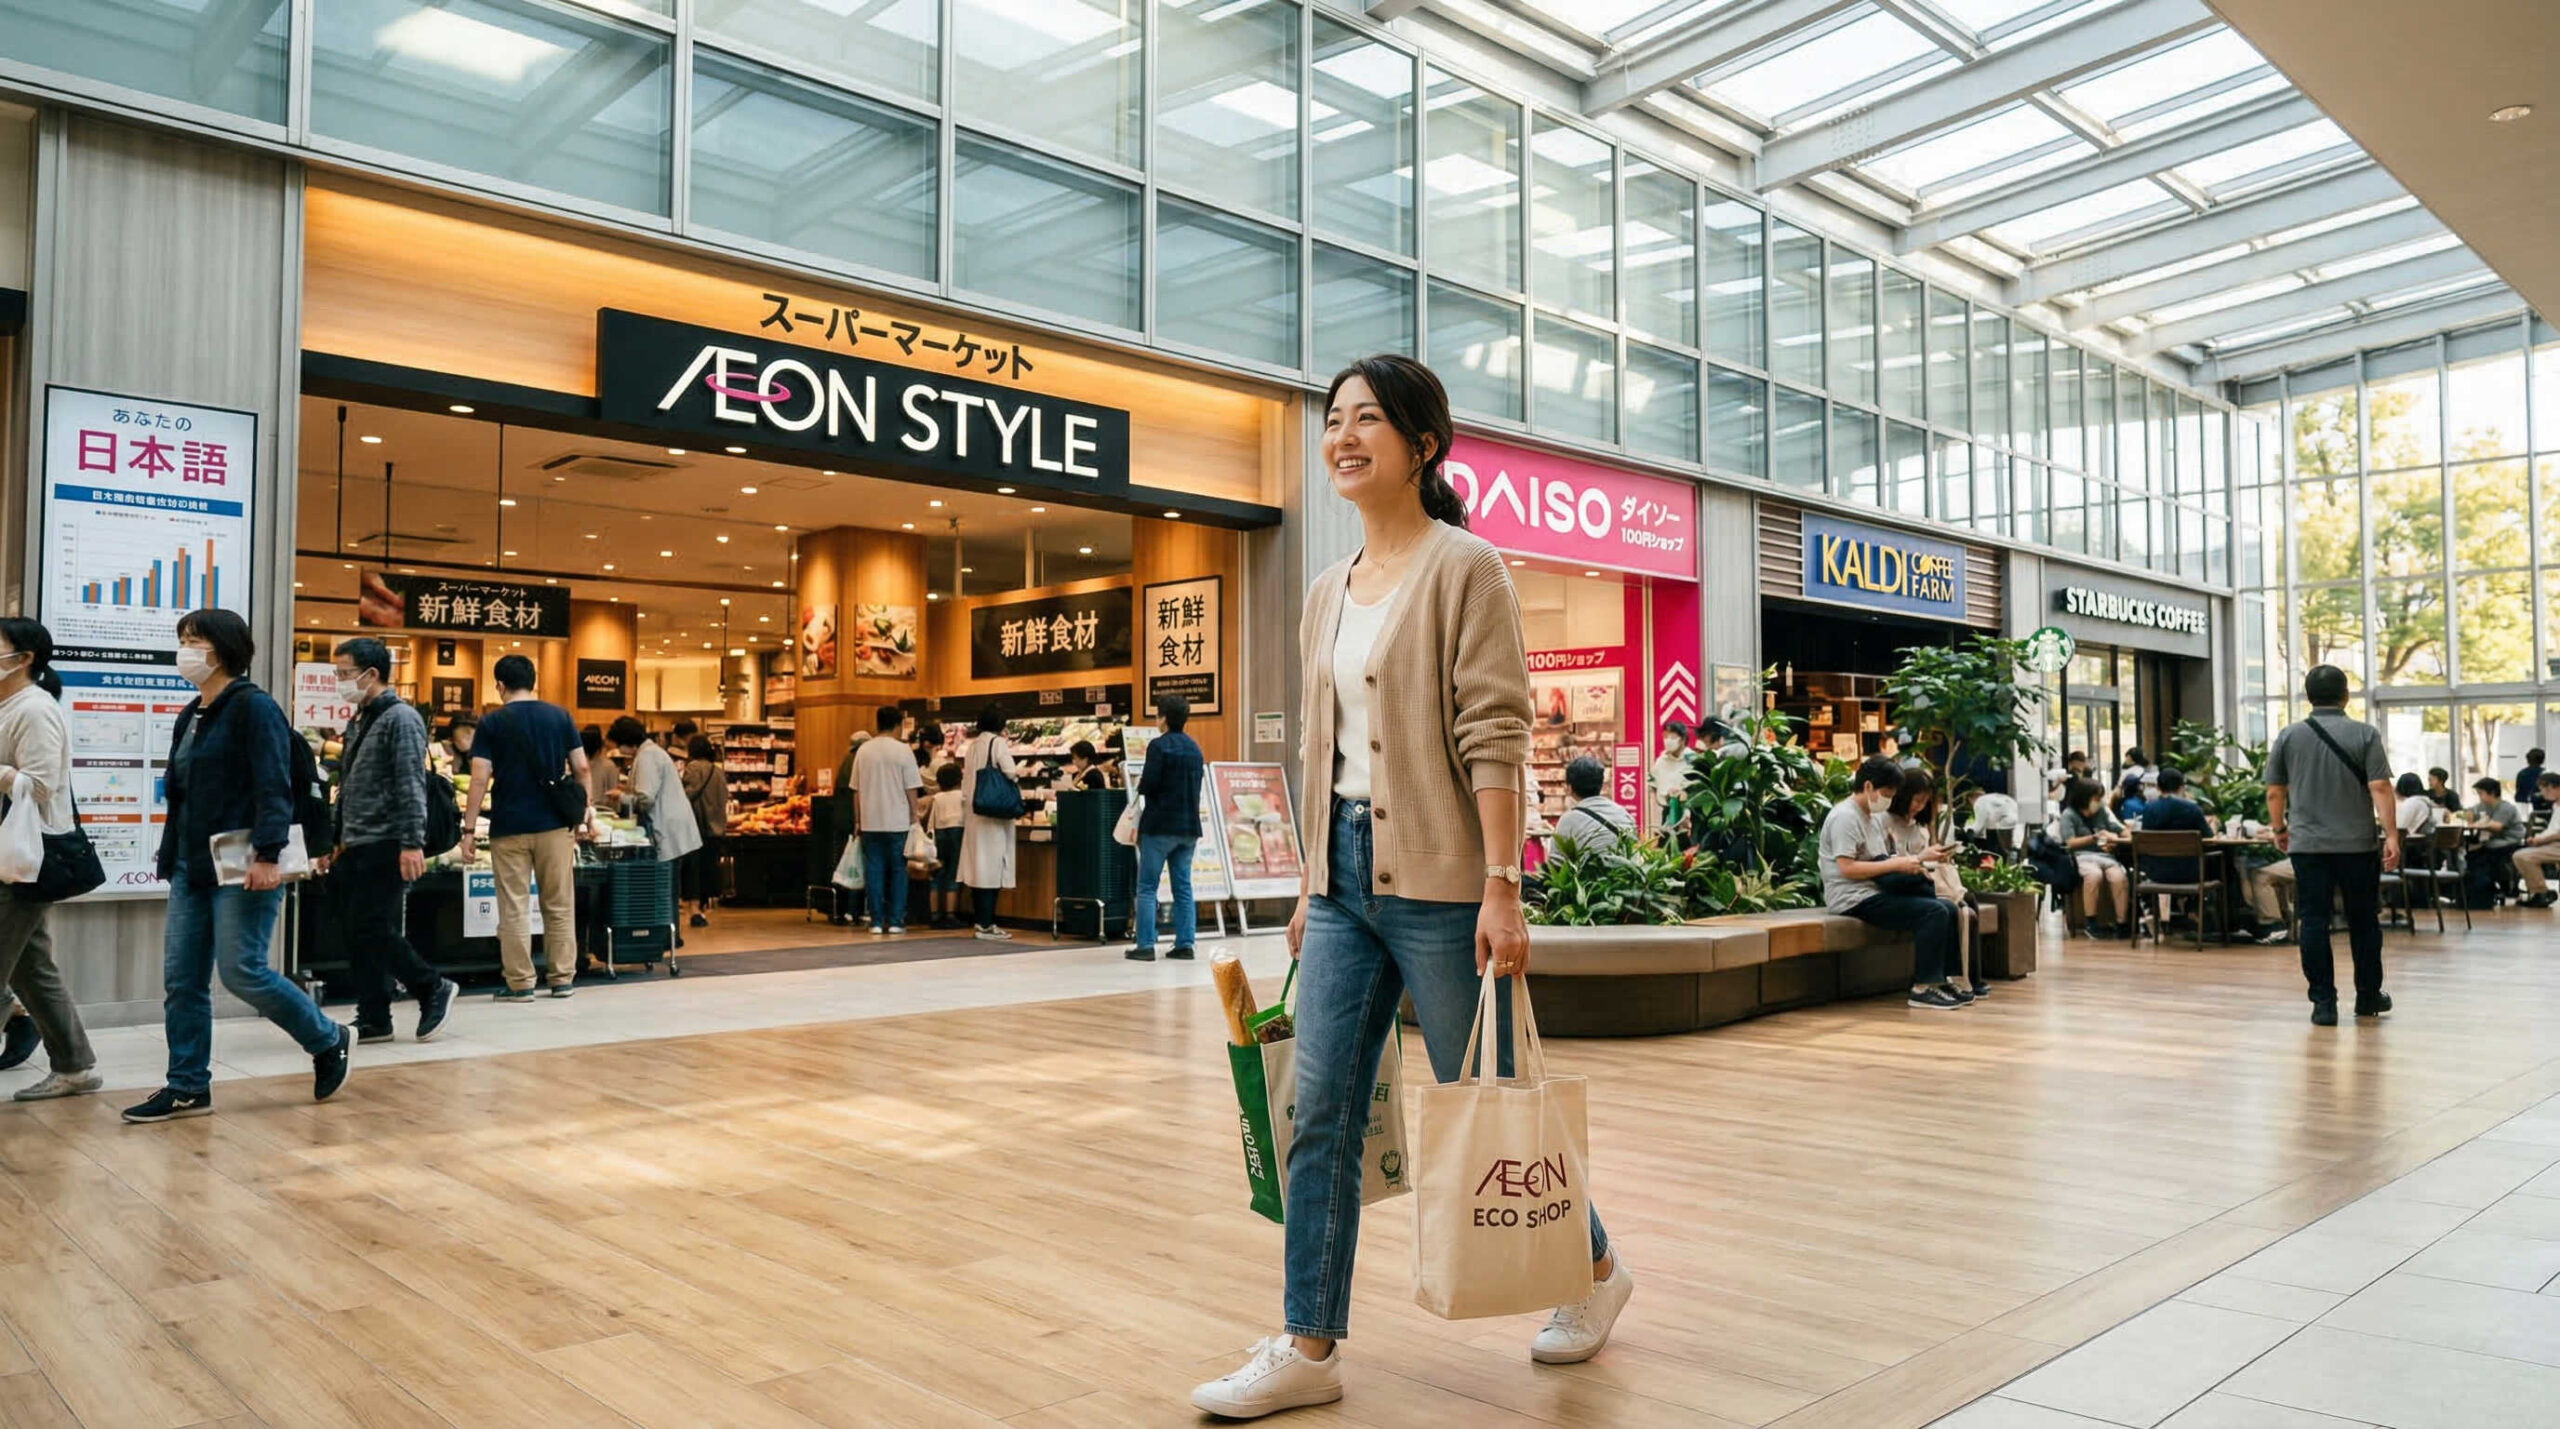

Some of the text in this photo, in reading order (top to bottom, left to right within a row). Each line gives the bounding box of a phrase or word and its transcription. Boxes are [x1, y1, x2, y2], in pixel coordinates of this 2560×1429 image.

[760, 293, 1034, 380] スーパーマーケット
[112, 408, 192, 432] あなたの
[900, 383, 1099, 479] STYLE
[78, 429, 228, 486] 日本語
[1444, 460, 1612, 539] DAISO
[1621, 495, 1681, 527] ダイソー
[1620, 527, 1684, 551] 100円ショップ
[1822, 532, 1907, 596] KALDI
[438, 582, 528, 598] スーパーマーケット
[1912, 574, 1955, 603] FARM
[418, 593, 543, 630] 新鮮食材
[1157, 594, 1205, 631] 新鮮
[2066, 586, 2207, 635] STARBUCKS COFFEE
[1000, 610, 1099, 658] 新鮮食材
[1157, 632, 1205, 669] 食材
[1527, 650, 1605, 669] 100円ショップ
[1474, 1199, 1571, 1229] ECO SHOP
